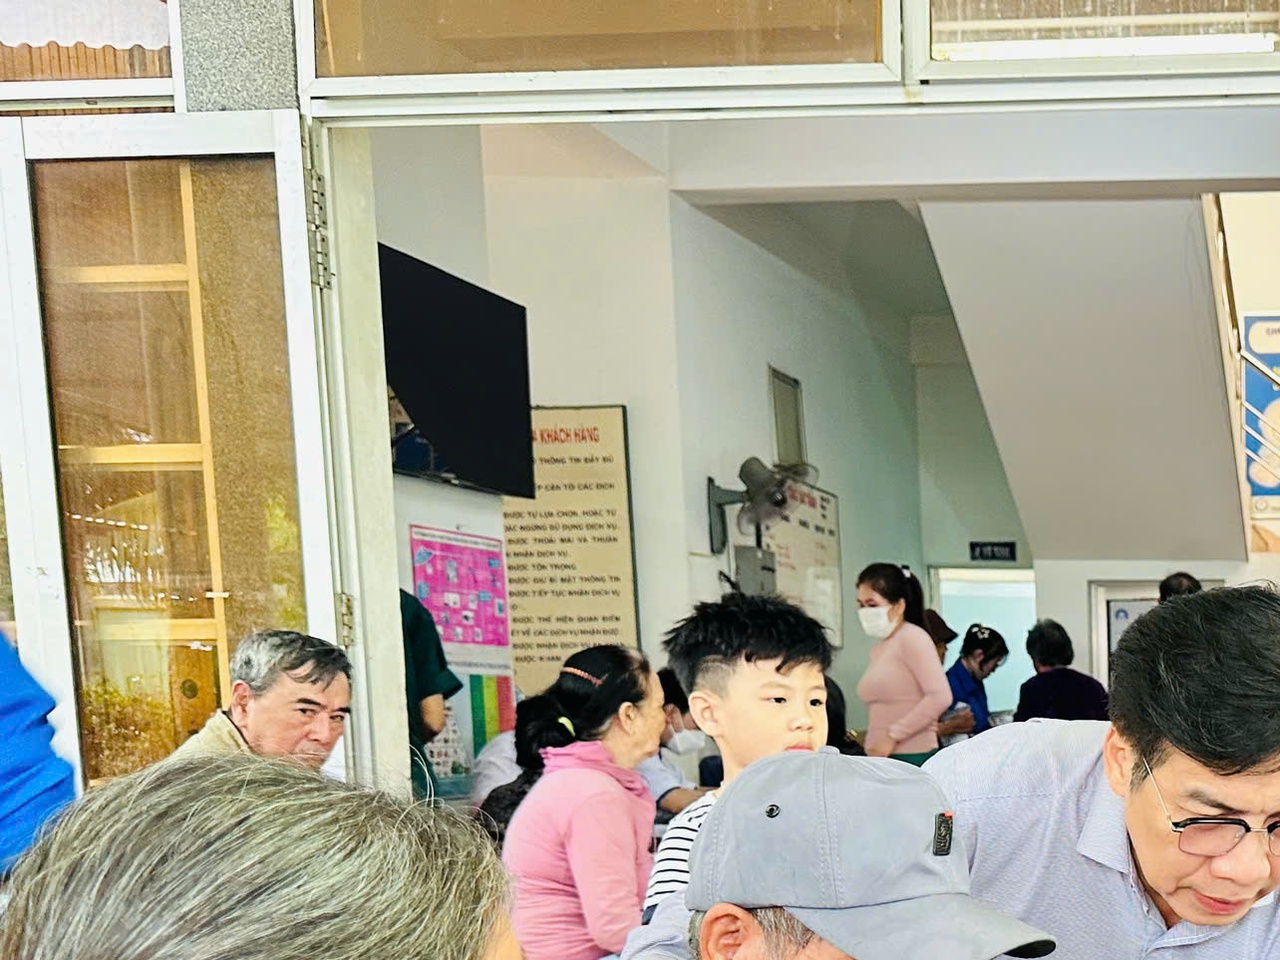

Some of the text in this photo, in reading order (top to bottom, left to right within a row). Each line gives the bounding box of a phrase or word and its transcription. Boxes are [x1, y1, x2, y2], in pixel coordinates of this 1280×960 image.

[540, 424, 571, 443] KHÁCH
[574, 424, 600, 443] HÀNG
[539, 455, 567, 465] THÔNG
